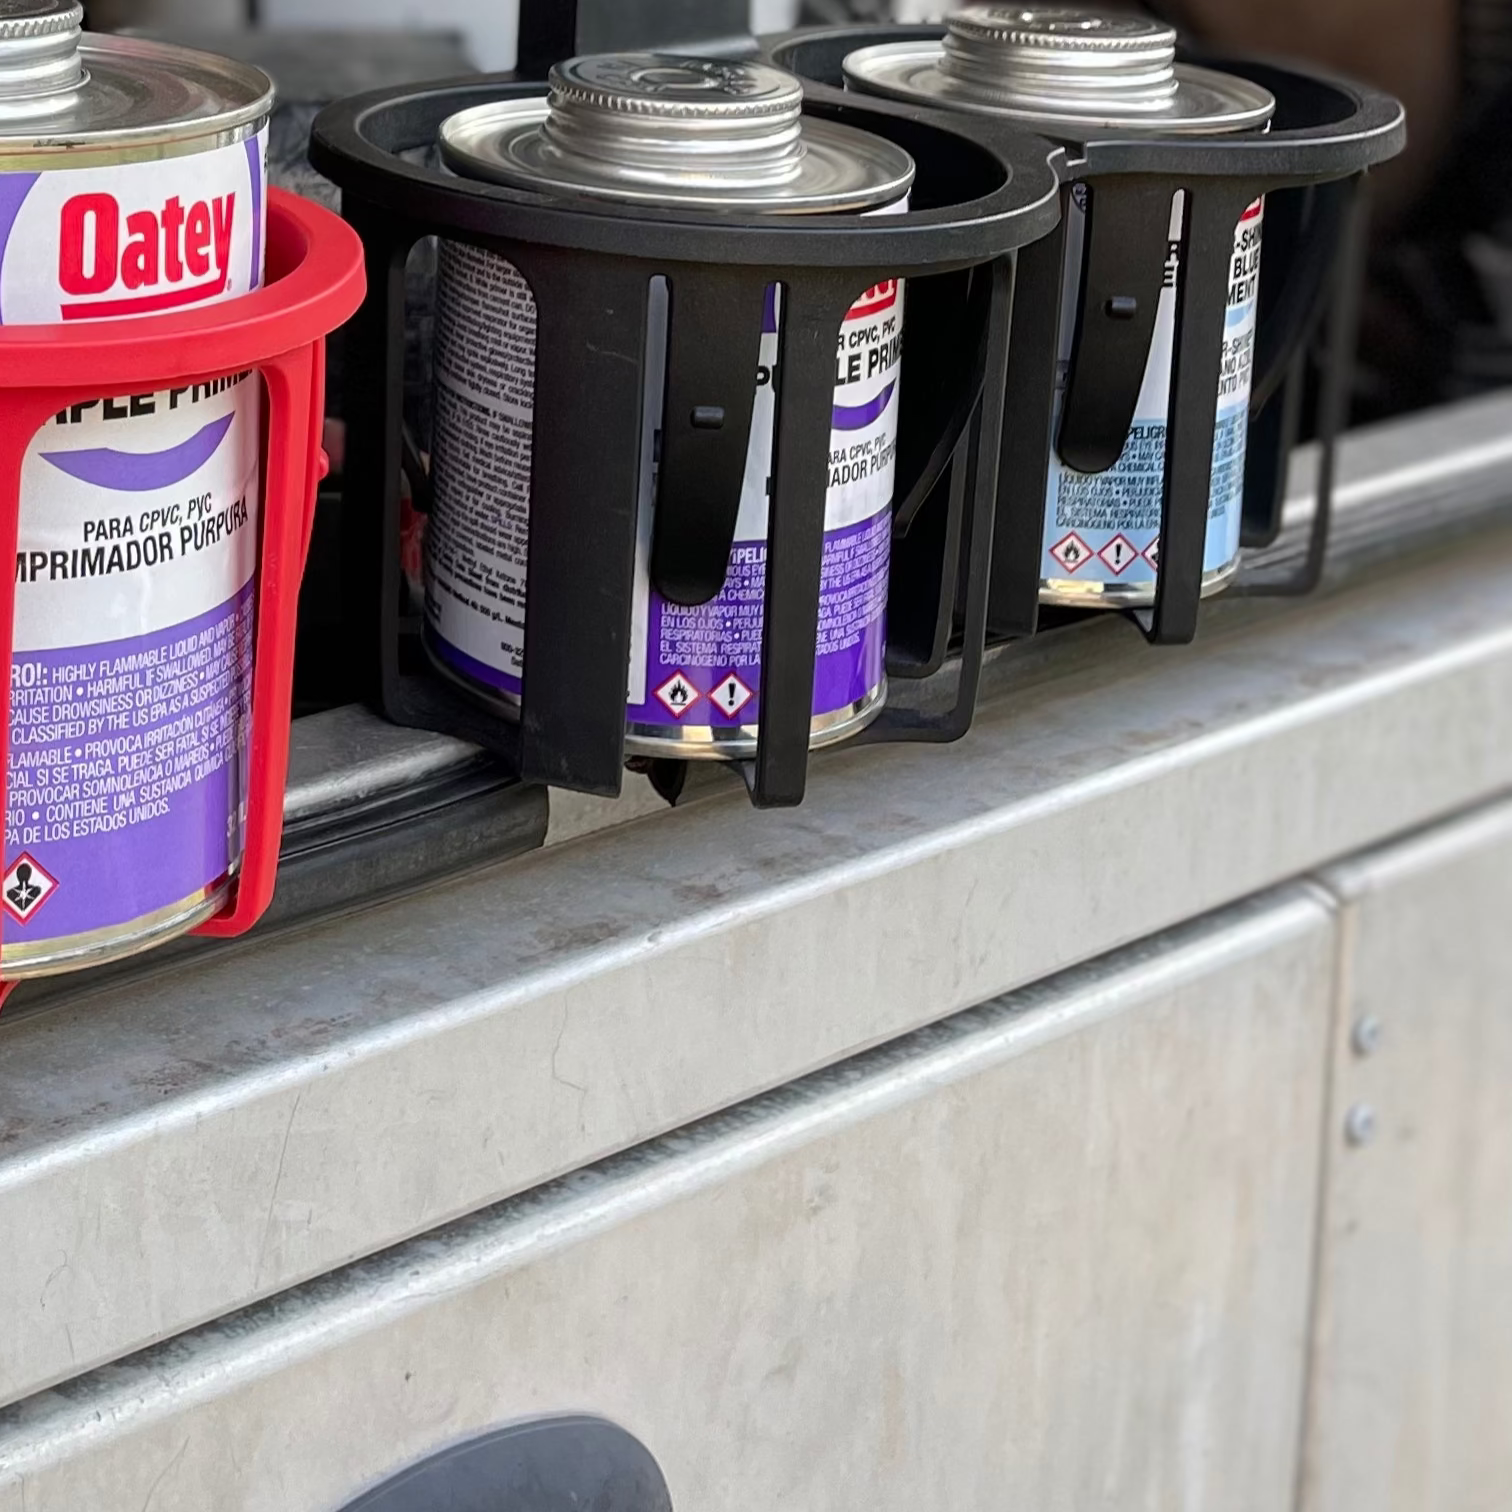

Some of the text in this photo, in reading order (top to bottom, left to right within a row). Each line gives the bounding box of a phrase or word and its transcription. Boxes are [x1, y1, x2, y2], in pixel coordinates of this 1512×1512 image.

[59, 191, 236, 296] Oatey
[1233, 250, 1258, 279] BLUE
[849, 316, 895, 349] CPVC, PVC
[849, 439, 872, 458] CPVC,
[84, 492, 211, 542] PARA CPVC, PVC
[181, 495, 248, 556] PURPURA
[661, 616, 675, 627] EN
[677, 618, 696, 628] LOS
[709, 606, 737, 617] VAPOR
[52, 662, 96, 684] HIGHLY
[99, 646, 168, 678] FLAMMABLE
[170, 635, 197, 660] LIQUID
[660, 640, 717, 654] EL SISTEMA
[729, 654, 747, 667] POR
[53, 670, 198, 722] DROWSINESS DIZZINESS
[87, 671, 143, 698] HARMFUL
[12, 712, 129, 745] CLASSIFIED THE
[85, 734, 142, 760] PROVOCA
[118, 741, 174, 772] PUEDE SER
[10, 763, 163, 808] PROVOCAR SOMNOLENCIA
[46, 770, 191, 822] CONTIENE UNA SUSTANCIA
[45, 822, 70, 842] LOS
[73, 810, 127, 837] ESTADOS
